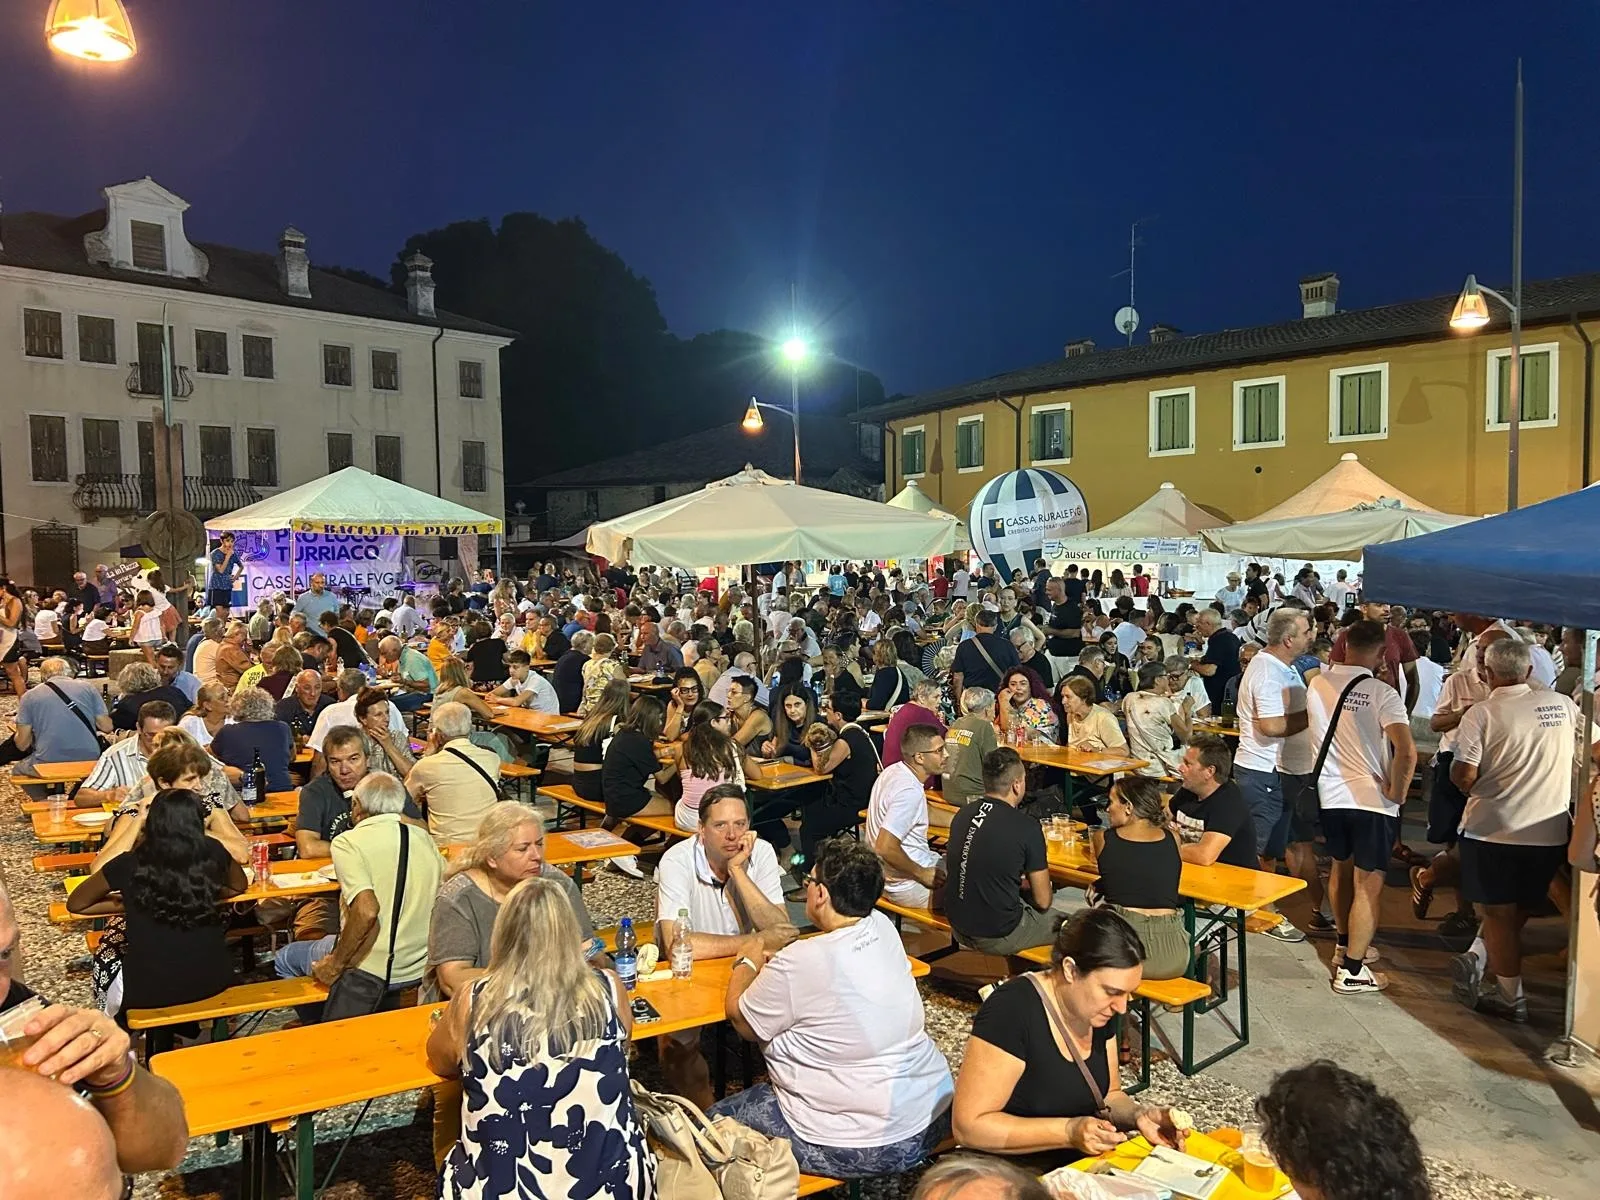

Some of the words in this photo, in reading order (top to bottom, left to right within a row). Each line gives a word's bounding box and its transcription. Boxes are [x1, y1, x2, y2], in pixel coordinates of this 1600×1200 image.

[1006, 515, 1037, 527] CASSA
[1038, 509, 1069, 522] RURALE
[424, 525, 478, 535] PIAZZA
[1007, 527, 1030, 536] CREDITO
[1030, 521, 1066, 532] COOERATVO
[275, 544, 380, 562] TURRIACO
[1065, 551, 1092, 559] auser
[1095, 545, 1149, 561] Turriaco
[252, 575, 304, 590] CASSA
[366, 572, 394, 586] FVG
[1344, 697, 1370, 707] OYALTY
[1349, 691, 1370, 700] SPECT
[1343, 704, 1359, 712] RUST
[971, 802, 993, 828] EA7
